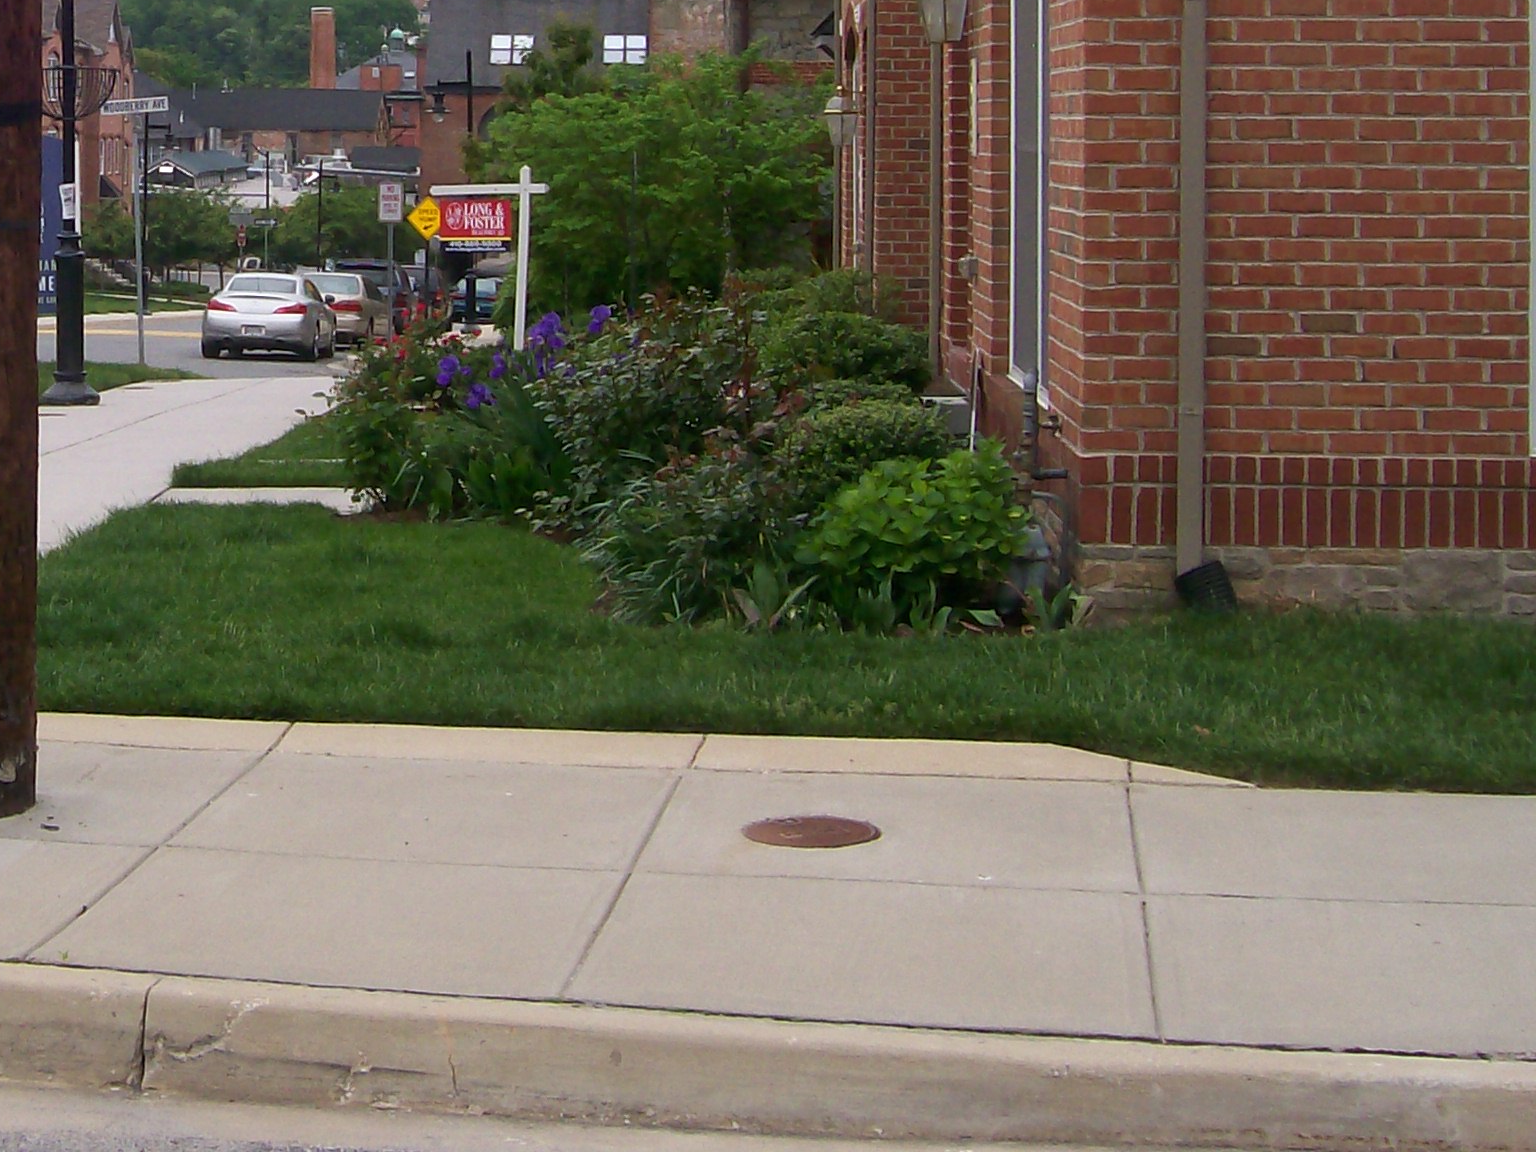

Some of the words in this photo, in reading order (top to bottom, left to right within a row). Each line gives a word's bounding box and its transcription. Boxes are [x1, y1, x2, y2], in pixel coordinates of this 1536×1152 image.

[152, 98, 166, 110] AVE
[464, 202, 492, 216] LONG
[495, 202, 504, 216] &
[464, 215, 504, 230] FOSTER
